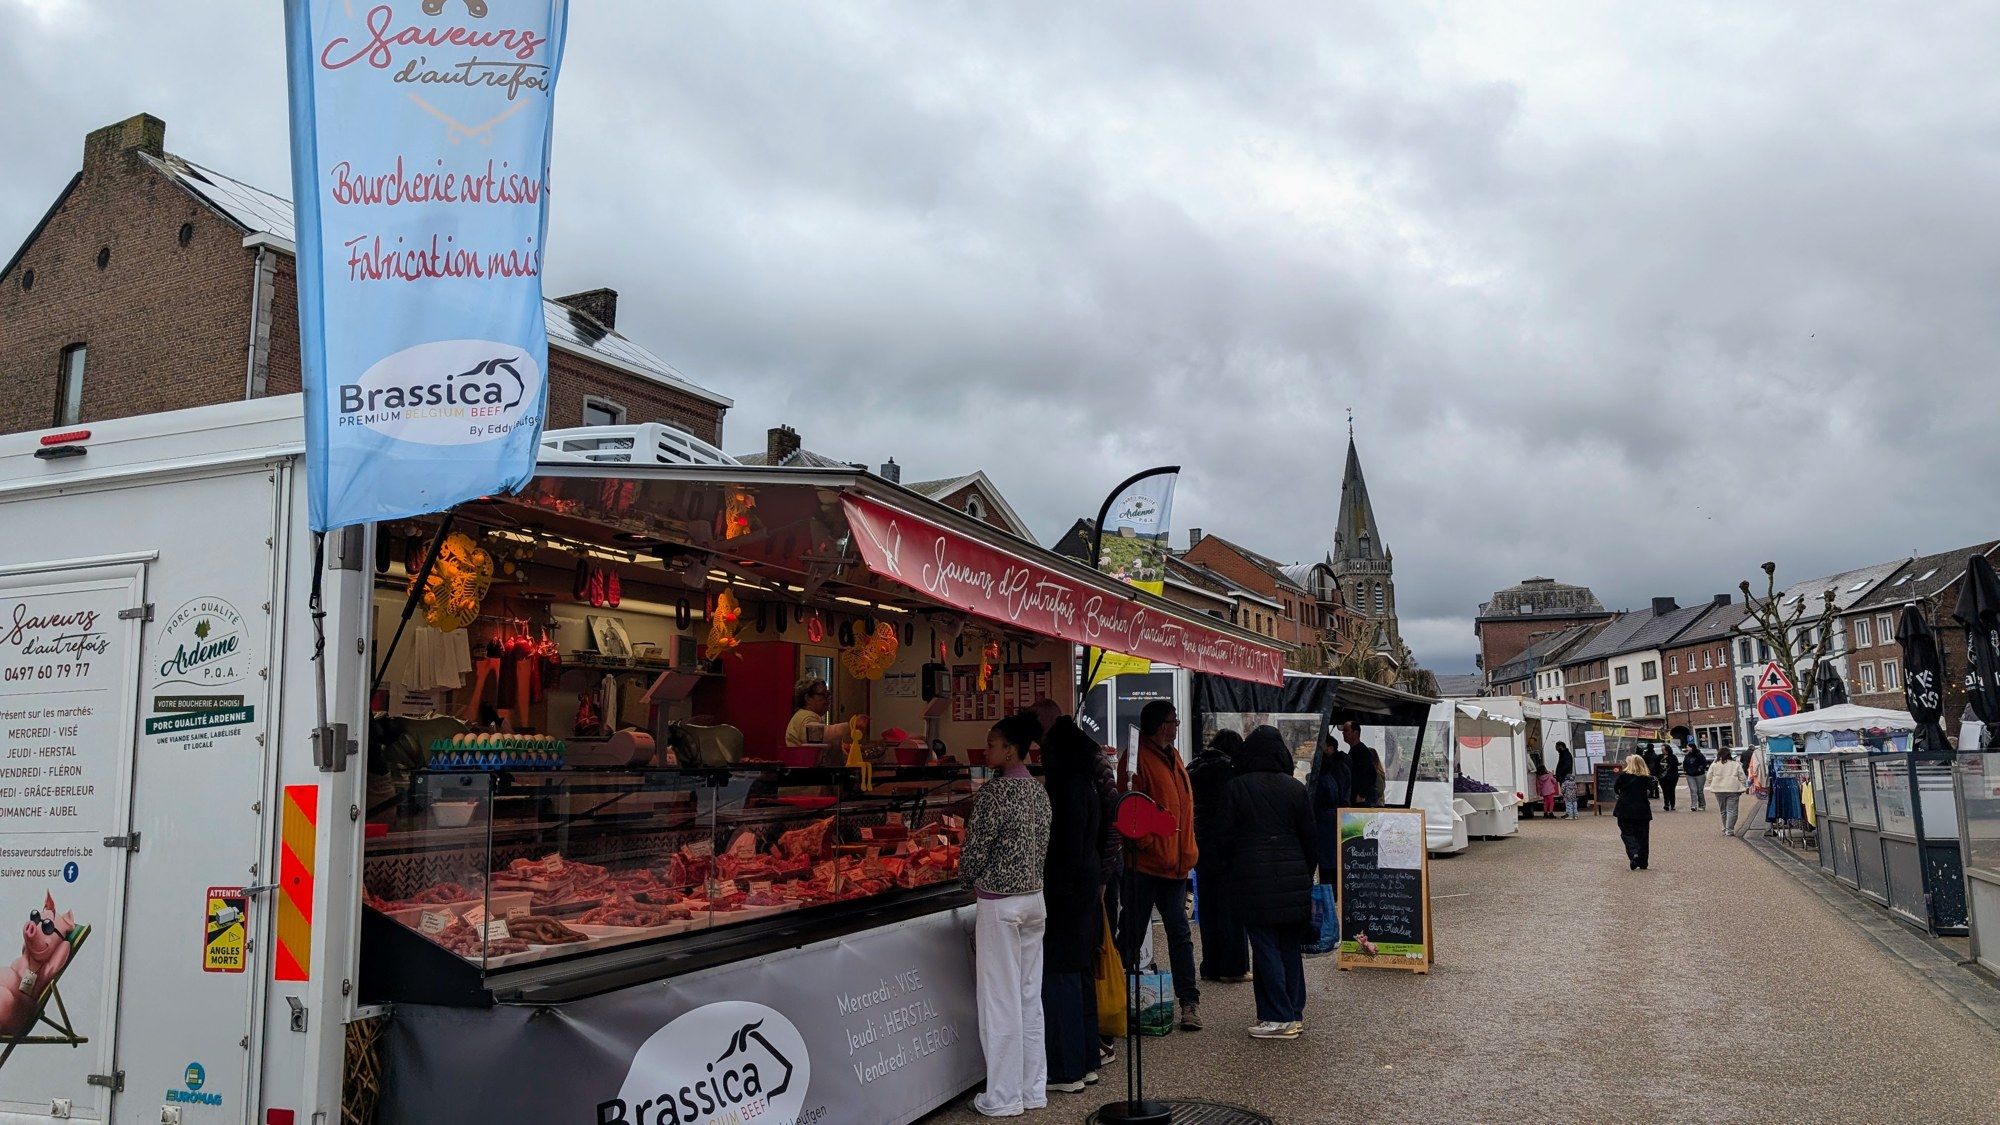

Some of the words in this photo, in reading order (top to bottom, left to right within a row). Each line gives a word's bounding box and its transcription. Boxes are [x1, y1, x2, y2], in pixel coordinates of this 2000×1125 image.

[320, 5, 546, 70] Saveurs
[331, 155, 457, 206] Bourcherie
[345, 233, 484, 282] Fabrication
[339, 374, 502, 414] Brassica
[339, 411, 401, 427] PREMIUM
[405, 407, 464, 420] BELGIUM
[470, 405, 501, 418] BEEF
[469, 425, 484, 437] By
[1118, 508, 1156, 519] Ardenne
[923, 536, 995, 598] Saveurs
[1082, 595, 1129, 643] Boucher
[167, 608, 190, 635] PORC
[200, 602, 240, 626] QUALITÉ
[22, 632, 111, 661] d'autrefois
[160, 635, 240, 677] Ardenne
[4, 666, 34, 682] 0497
[37, 664, 52, 680] 60
[56, 664, 71, 678] 79
[75, 662, 90, 677] 77
[157, 699, 177, 708] VOTRE
[178, 699, 212, 708] BOUCHERIE
[219, 699, 240, 707] CHOISI
[27, 710, 41, 719] sur
[43, 708, 55, 718] les
[153, 720, 173, 731] PORC
[174, 714, 207, 729] QUALITÉ
[208, 711, 247, 724] ARDENNE
[8, 727, 51, 739] MERCREDI
[58, 724, 78, 737] VISÉ
[156, 737, 169, 745] UNE
[169, 734, 190, 744] VIANDE
[210, 728, 242, 739] LABÉLISÉE
[6, 747, 32, 759] JEUDI
[39, 746, 77, 758] HERSTAL
[183, 743, 191, 751] ET
[191, 740, 214, 750] LOCALE
[0, 767, 41, 778] VENDREDI
[48, 764, 82, 777] FLÉRON
[24, 784, 95, 797] GRÂCE-BERLEUR
[49, 806, 78, 817] AUBEL
[0, 867, 25, 878] suivez
[27, 868, 46, 878] nous
[48, 868, 62, 878] sur
[209, 946, 240, 956] ANGLES
[211, 955, 238, 965] MORTS
[836, 978, 891, 1017] Mercredi
[894, 963, 924, 994] VISÉ
[846, 1019, 878, 1057] Jeudi
[883, 998, 939, 1036] HERSTAL
[853, 1043, 907, 1085] Vendredi
[912, 1020, 960, 1060] FLÉRON
[166, 1089, 223, 1106] EUROMAG
[740, 1098, 766, 1121] BEEF
